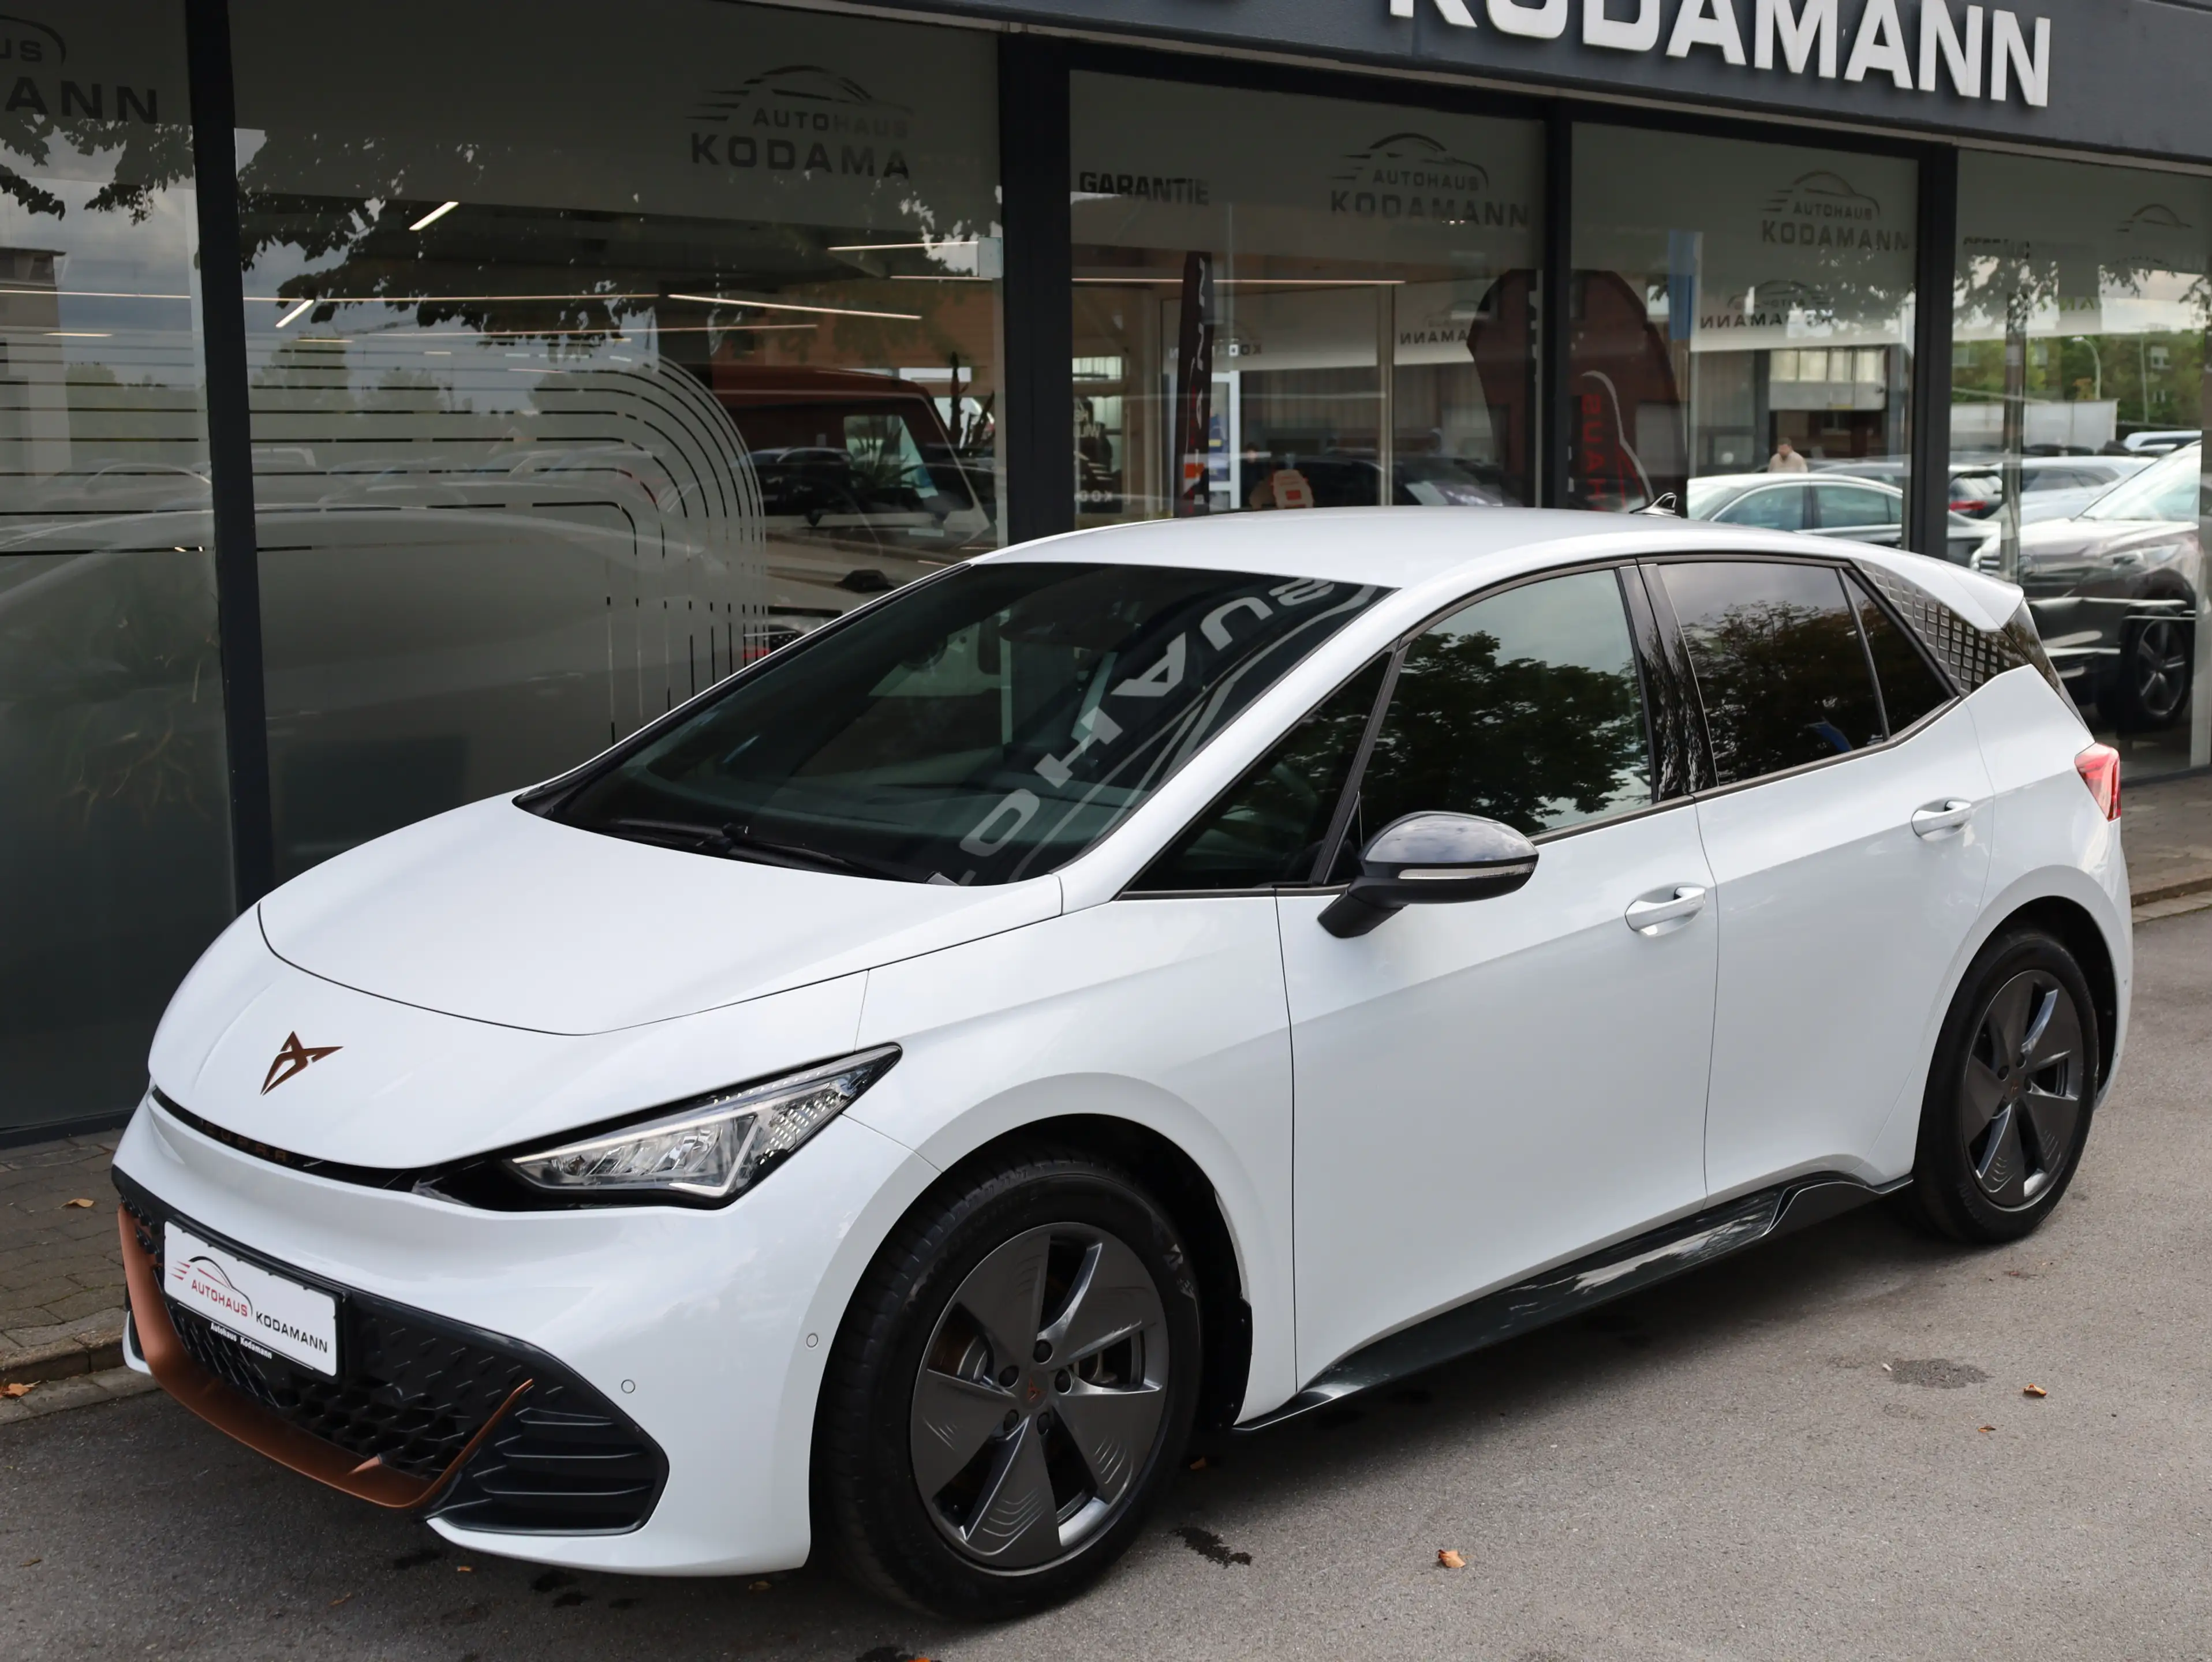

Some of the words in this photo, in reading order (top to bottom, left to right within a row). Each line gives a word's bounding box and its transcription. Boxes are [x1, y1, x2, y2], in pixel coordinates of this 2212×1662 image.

[1390, 0, 2051, 107] AMANN
[752, 107, 909, 139] AUTOHAUS
[1079, 171, 1209, 206] GARANTIE
[1372, 169, 1481, 191] AUTOHAUS
[1330, 189, 1529, 227] KODAMANN
[1792, 201, 1873, 221] AUTOHAUS
[1762, 219, 1910, 252] KODAMANN
[191, 1279, 248, 1317] AUTOHAUS
[255, 1311, 328, 1354] KODAMANN
[210, 1322, 237, 1342] Autohaus
[240, 1336, 273, 1360] Kodamann
